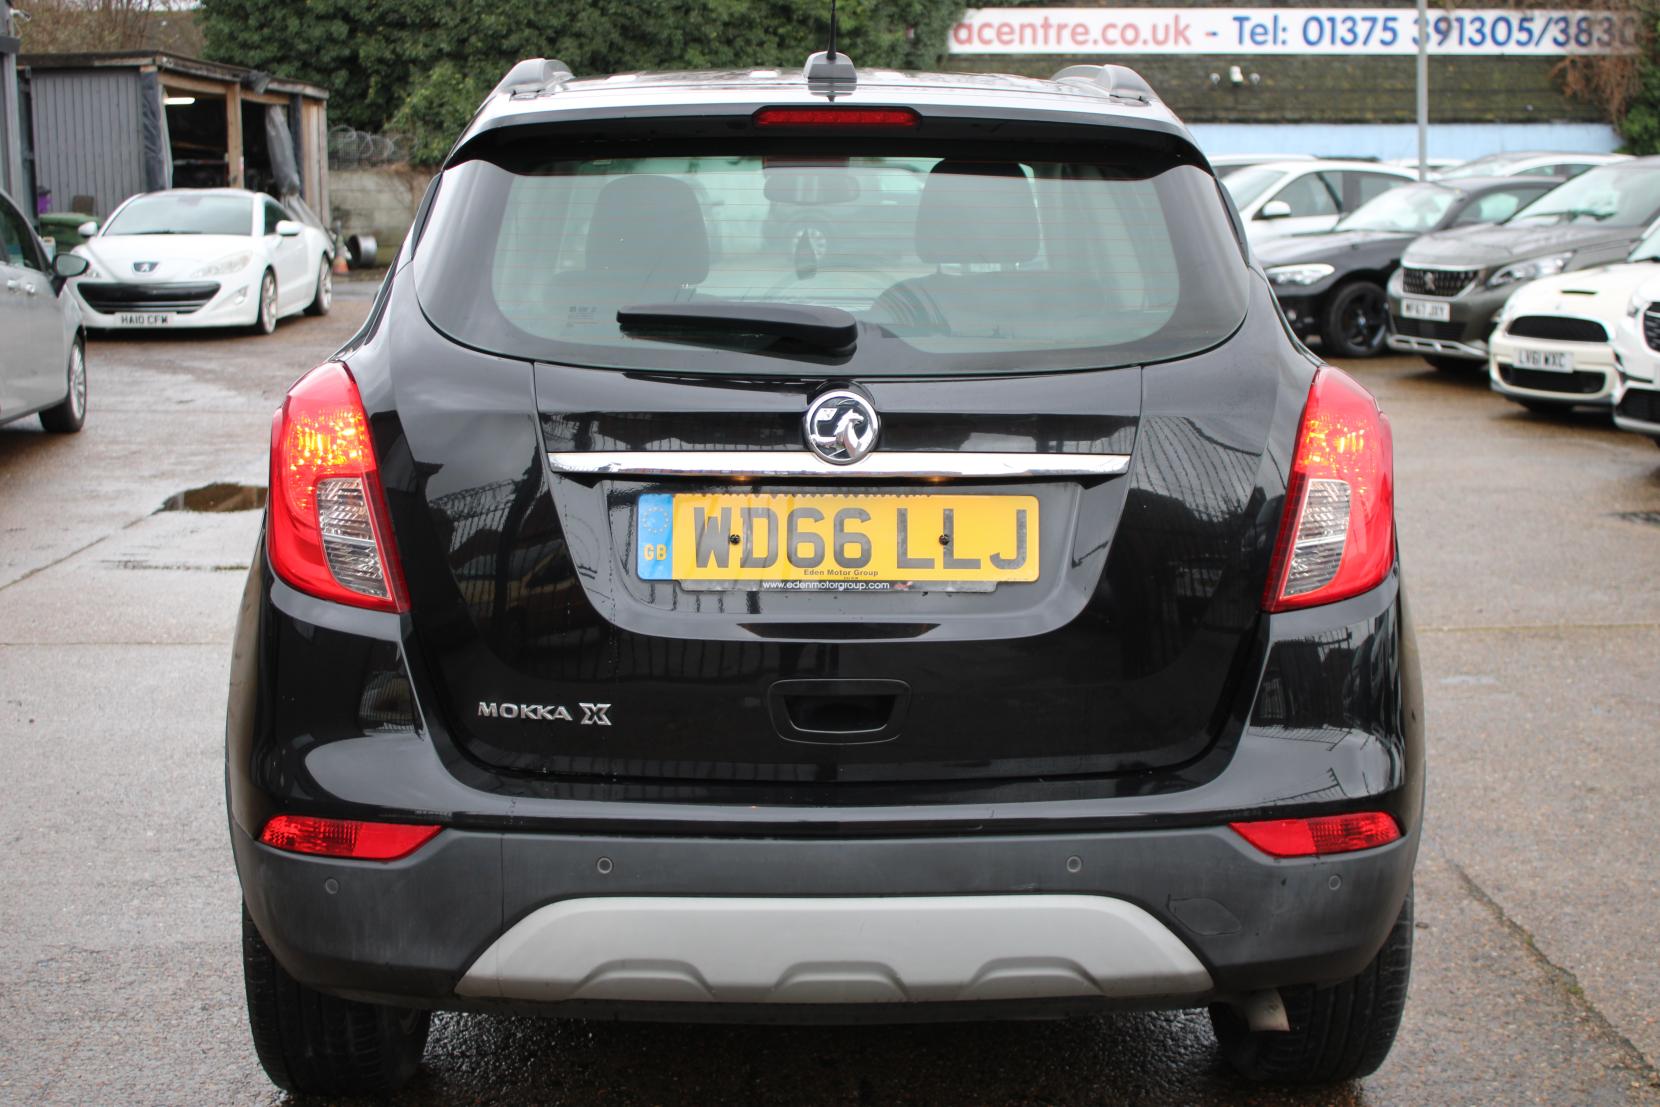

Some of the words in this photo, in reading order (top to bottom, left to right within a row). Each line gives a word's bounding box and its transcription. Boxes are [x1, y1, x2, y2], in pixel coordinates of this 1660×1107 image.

[1232, 14, 1288, 46] Tel:
[1302, 15, 1399, 46] 01375
[693, 507, 873, 569] WD66
[896, 507, 1028, 570] LLJ
[643, 543, 667, 561] GB
[803, 568, 825, 576] Eden
[827, 568, 851, 576] Motor
[854, 568, 879, 577] Group
[762, 580, 891, 591] www.edenmotorgroup.com
[477, 701, 573, 721] MOKKA
[578, 702, 612, 726] X
